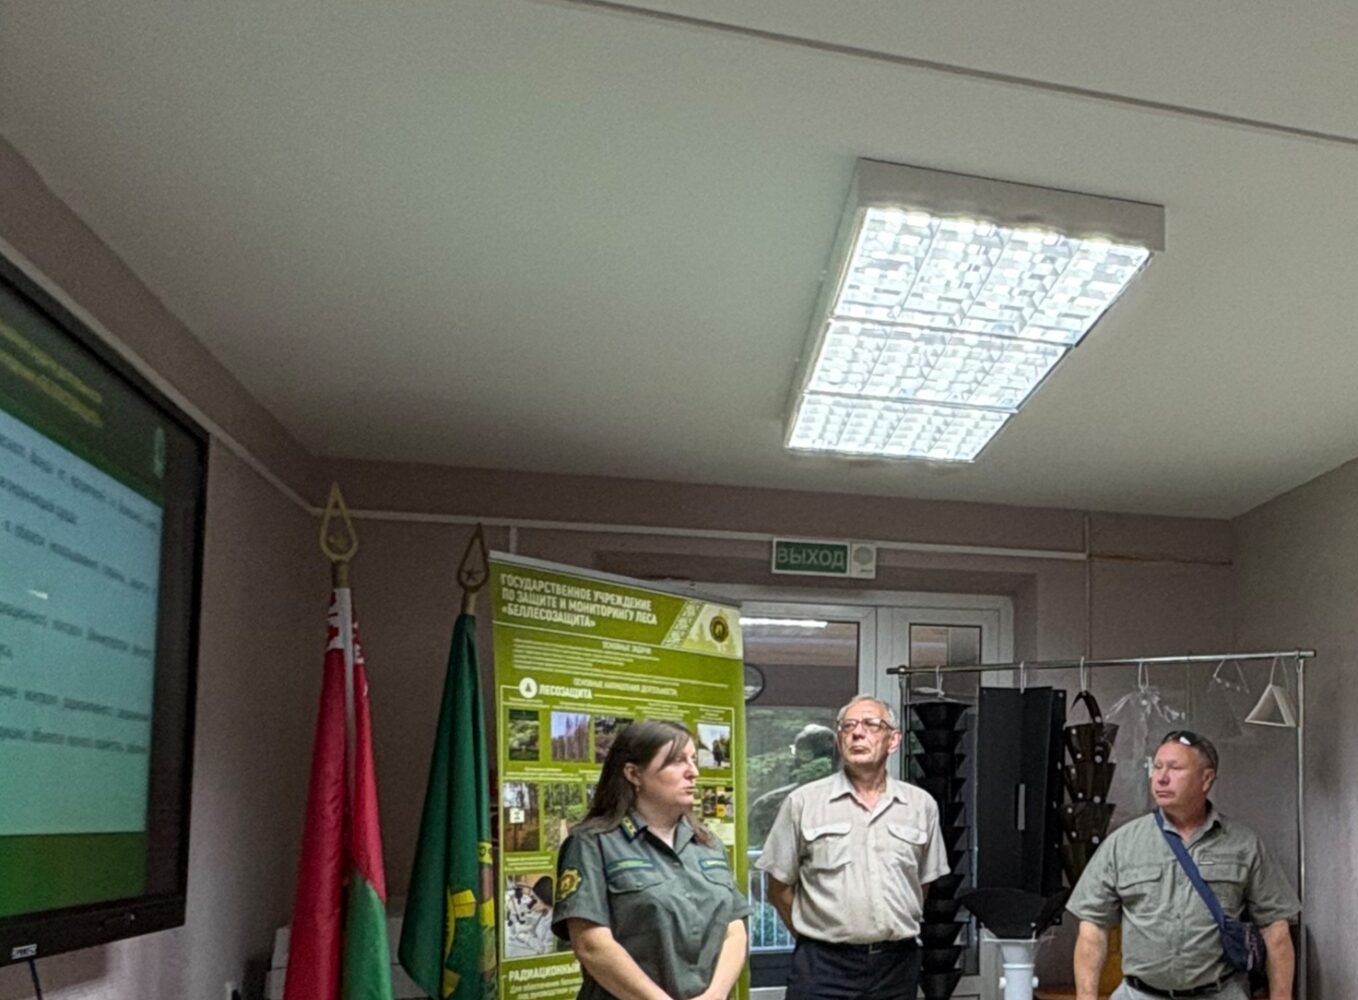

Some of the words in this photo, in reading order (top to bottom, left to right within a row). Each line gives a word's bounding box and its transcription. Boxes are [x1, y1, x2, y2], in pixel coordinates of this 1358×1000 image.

[777, 547, 845, 570] ВЫХОД
[500, 573, 591, 601] ГОСУДАРСТВЕННОЕ
[593, 590, 652, 612] УЧРЕЖДЕНИЕ
[502, 587, 516, 601] ПО
[516, 589, 557, 609] ЗАЩИТЕ
[559, 598, 567, 609] И
[568, 599, 634, 621] МОНИТОРИНГУ
[635, 611, 658, 626] ЛЕСА
[501, 602, 596, 628] «БЕЛЛЕСОЗАЩИТА»
